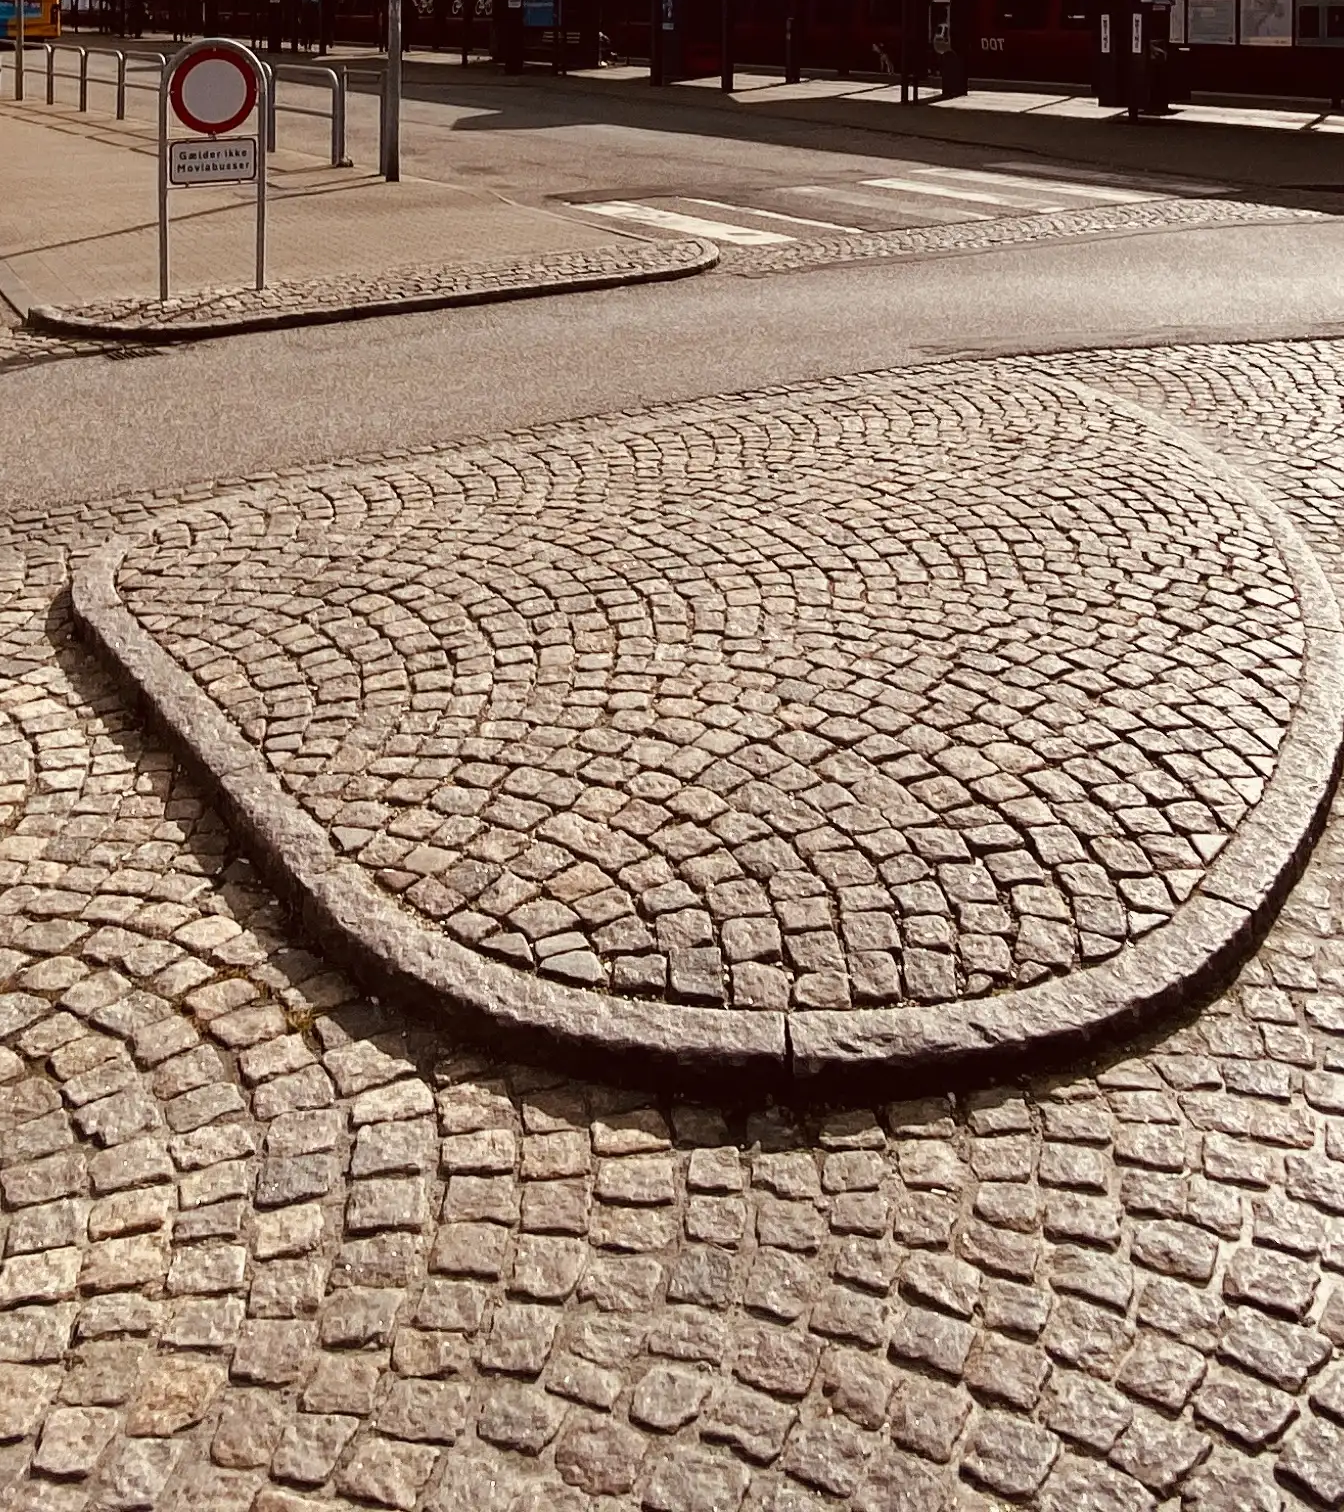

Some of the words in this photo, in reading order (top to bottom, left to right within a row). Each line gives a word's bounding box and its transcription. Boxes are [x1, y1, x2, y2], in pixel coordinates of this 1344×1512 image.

[980, 37, 1005, 52] DOT
[179, 150, 221, 160] Gælder
[225, 149, 247, 158] ikke
[177, 162, 250, 173] Moviabusser
